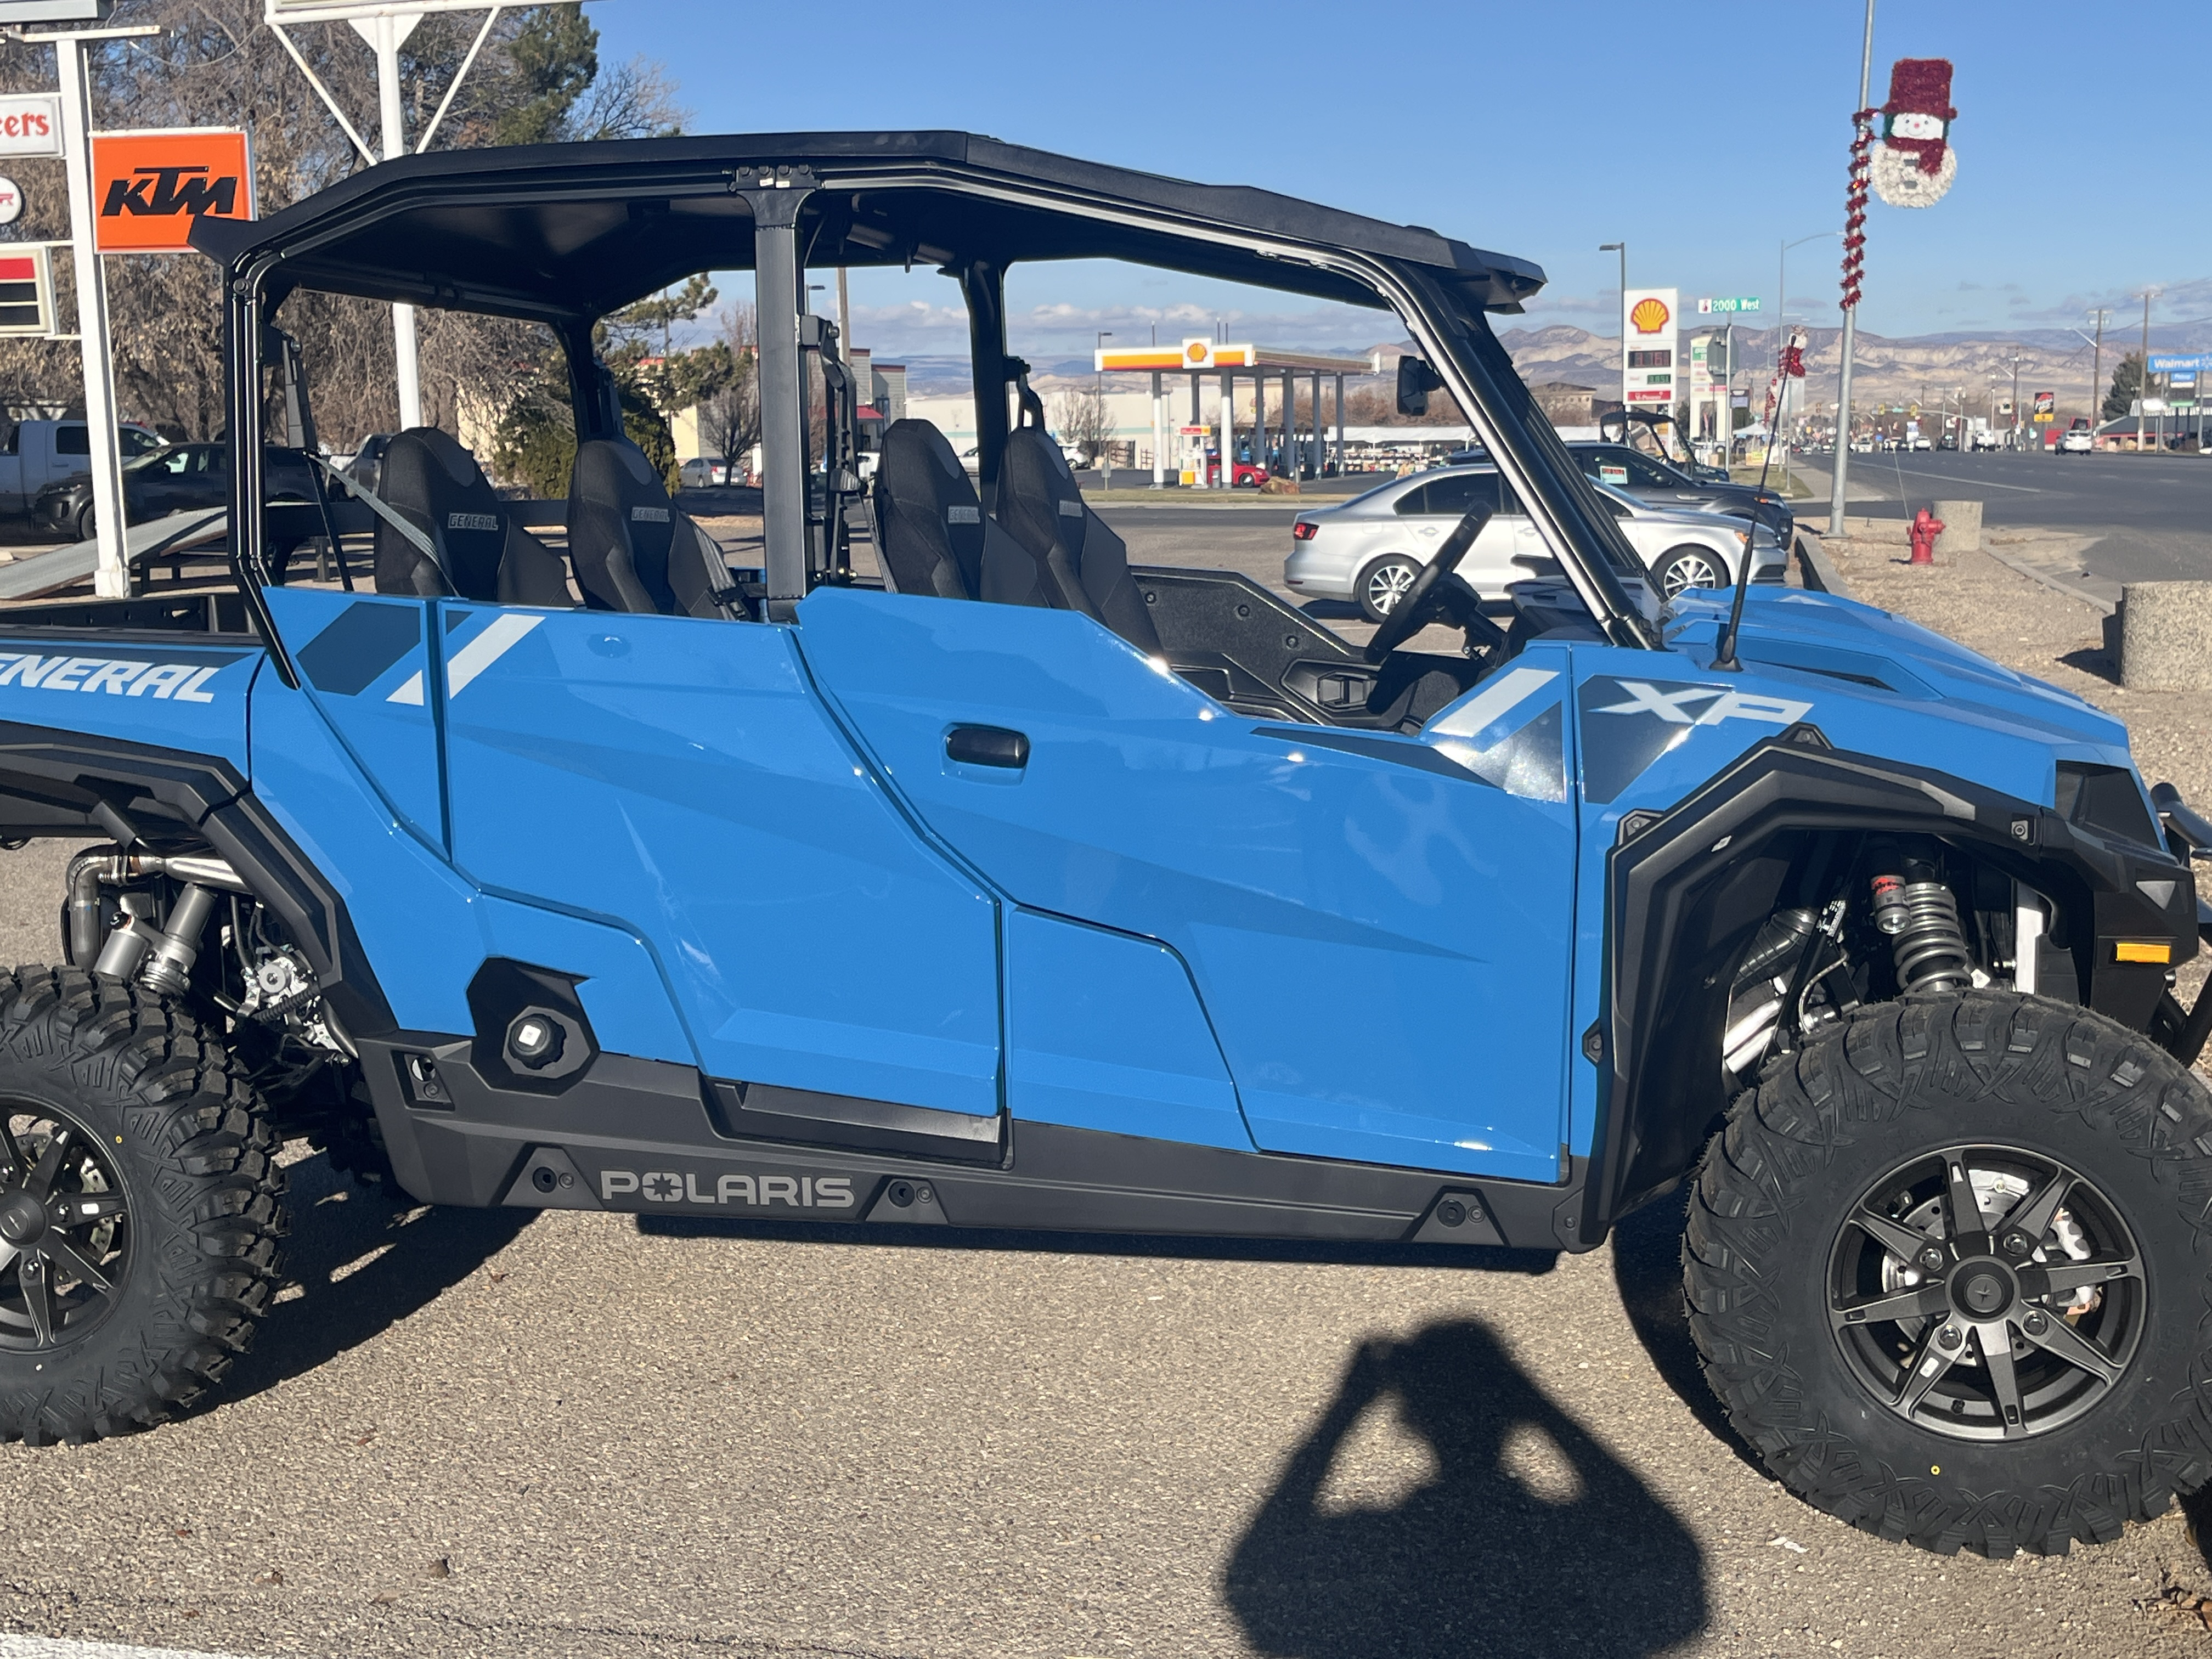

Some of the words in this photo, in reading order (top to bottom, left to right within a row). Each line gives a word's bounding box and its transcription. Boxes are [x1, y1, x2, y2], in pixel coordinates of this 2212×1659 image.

[0, 112, 50, 138] ers
[101, 166, 238, 217] KTM
[1712, 300, 1737, 312] 2000
[1740, 298, 1759, 311] West
[2154, 358, 2200, 369] Walmart
[449, 514, 498, 529] GENERAL
[632, 508, 670, 522] GENERAL
[1587, 679, 1814, 726] XP
[600, 1170, 855, 1207] POLARIS
